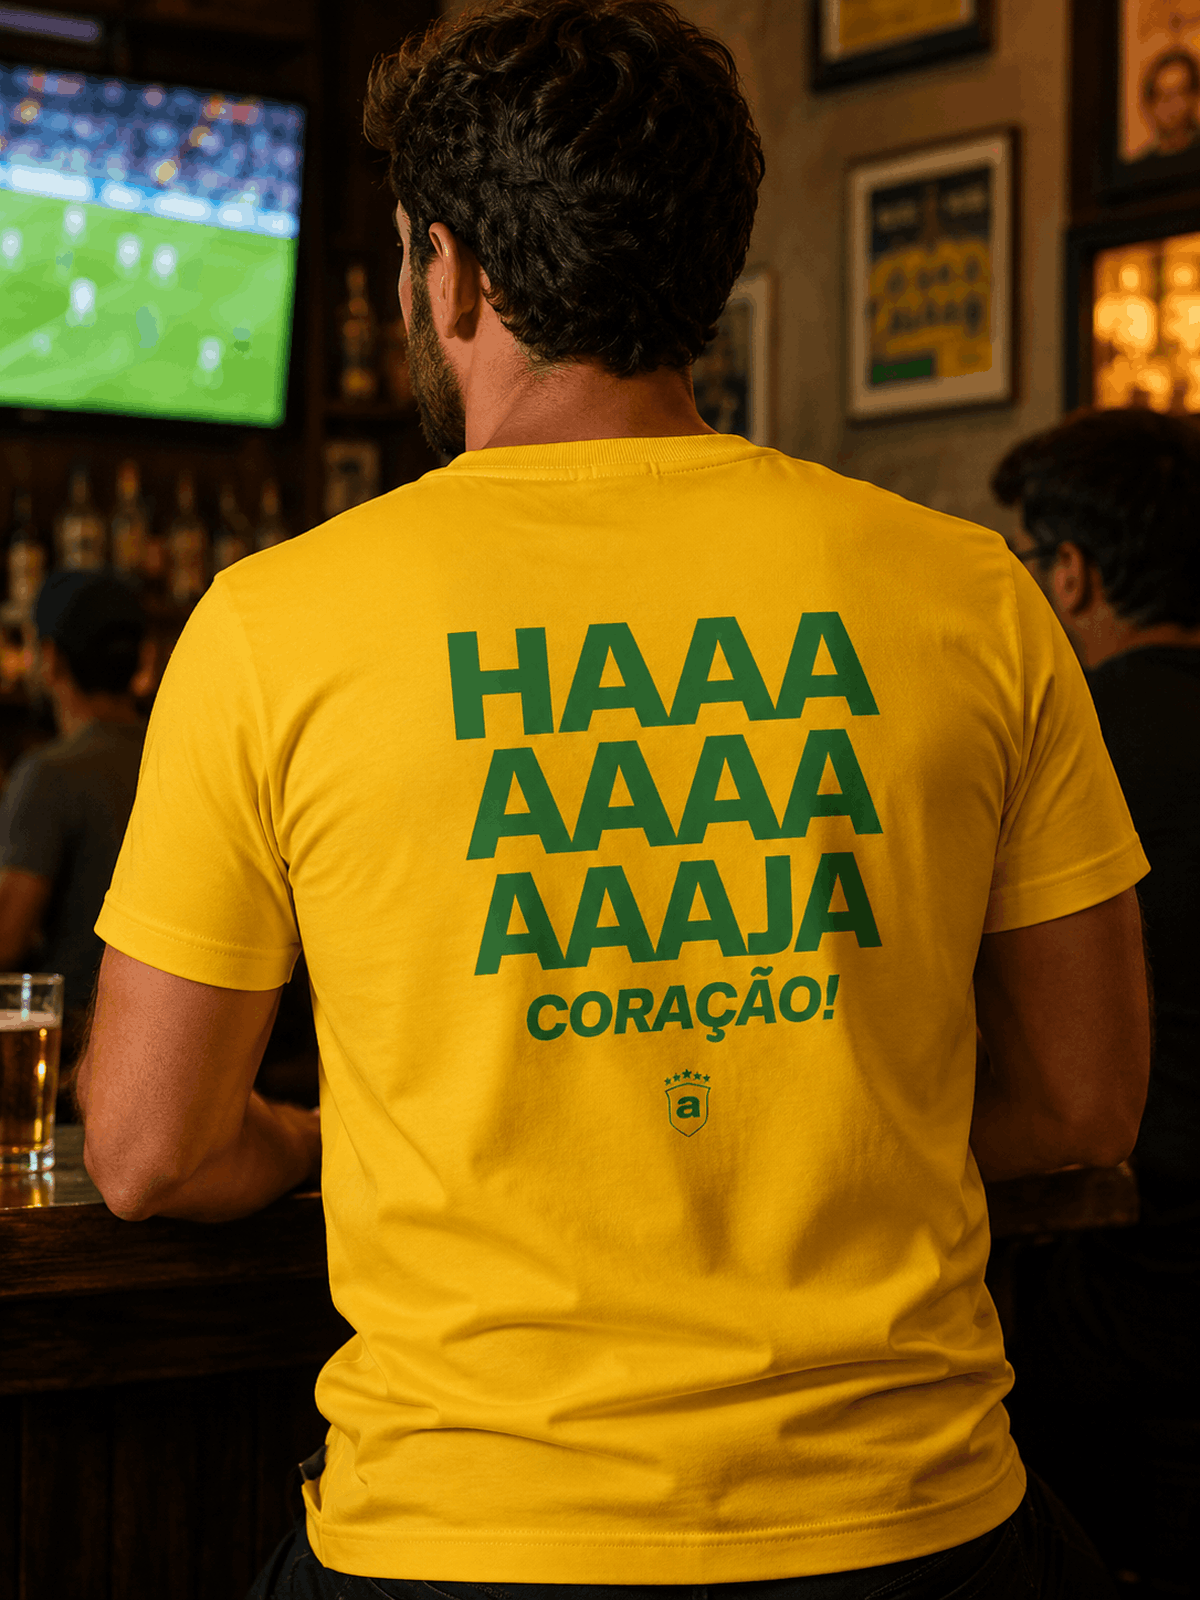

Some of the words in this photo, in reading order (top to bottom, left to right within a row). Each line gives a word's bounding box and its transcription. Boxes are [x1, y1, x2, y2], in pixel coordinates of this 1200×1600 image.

[447, 611, 880, 740] HAAA
[466, 729, 884, 860] AAAA
[474, 851, 883, 976] AAAJA
[526, 966, 840, 1043] CORAÇÃO!
[676, 1096, 701, 1118] a
